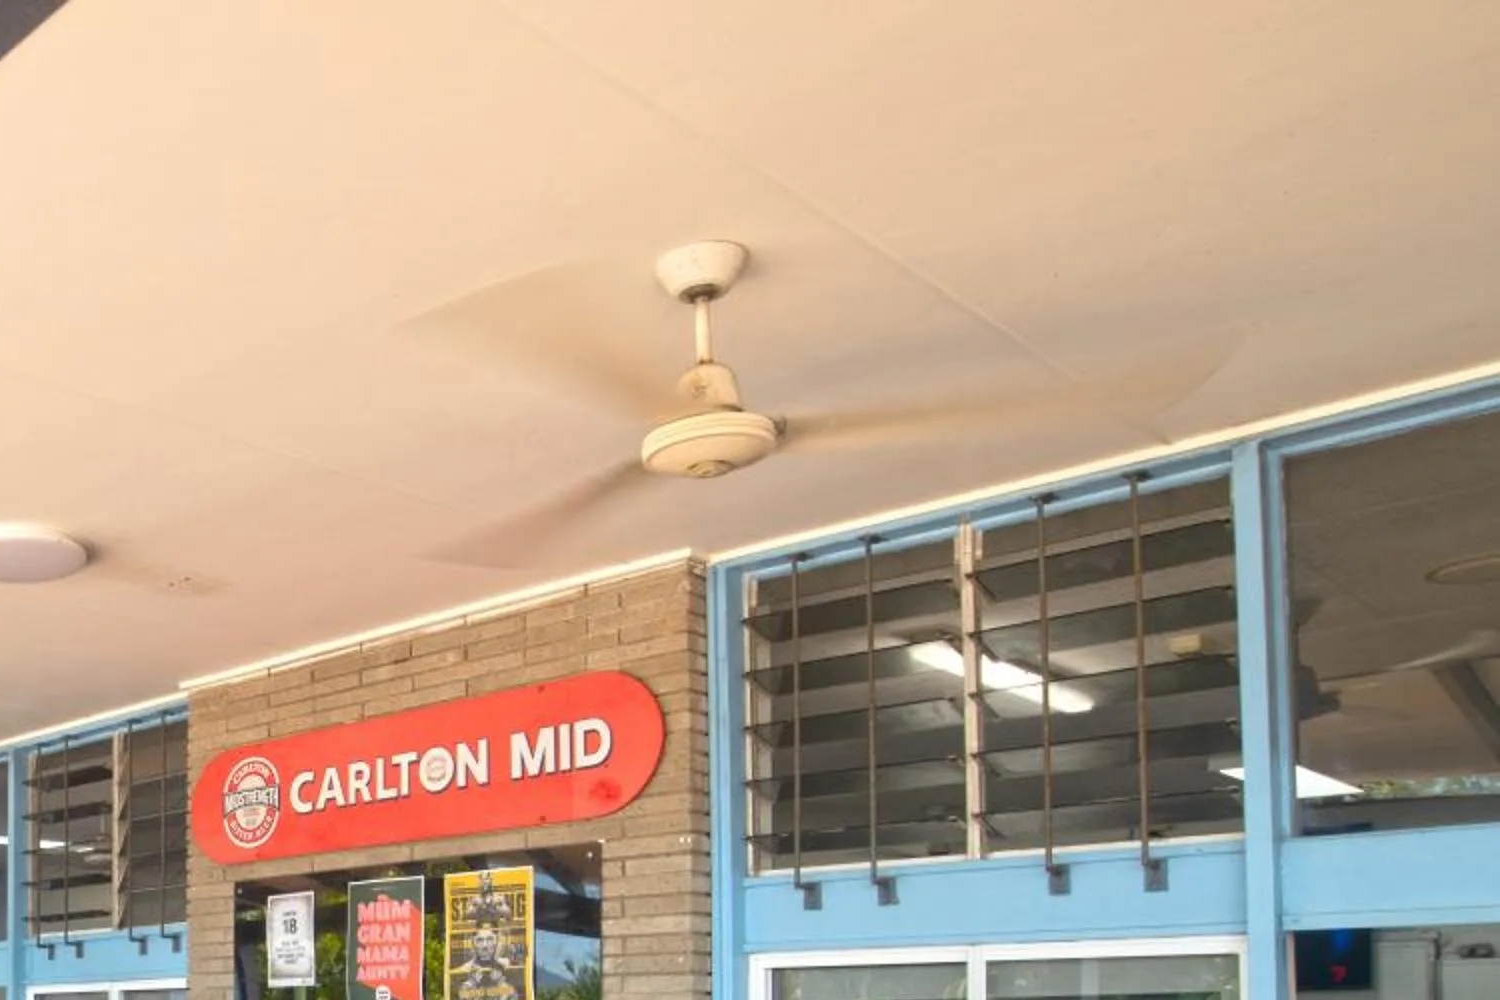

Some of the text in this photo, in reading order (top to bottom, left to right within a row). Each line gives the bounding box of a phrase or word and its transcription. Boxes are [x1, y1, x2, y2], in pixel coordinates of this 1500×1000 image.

[289, 738, 489, 814] CARLTON
[510, 718, 613, 780] MID
[357, 922, 411, 944] GRAN
